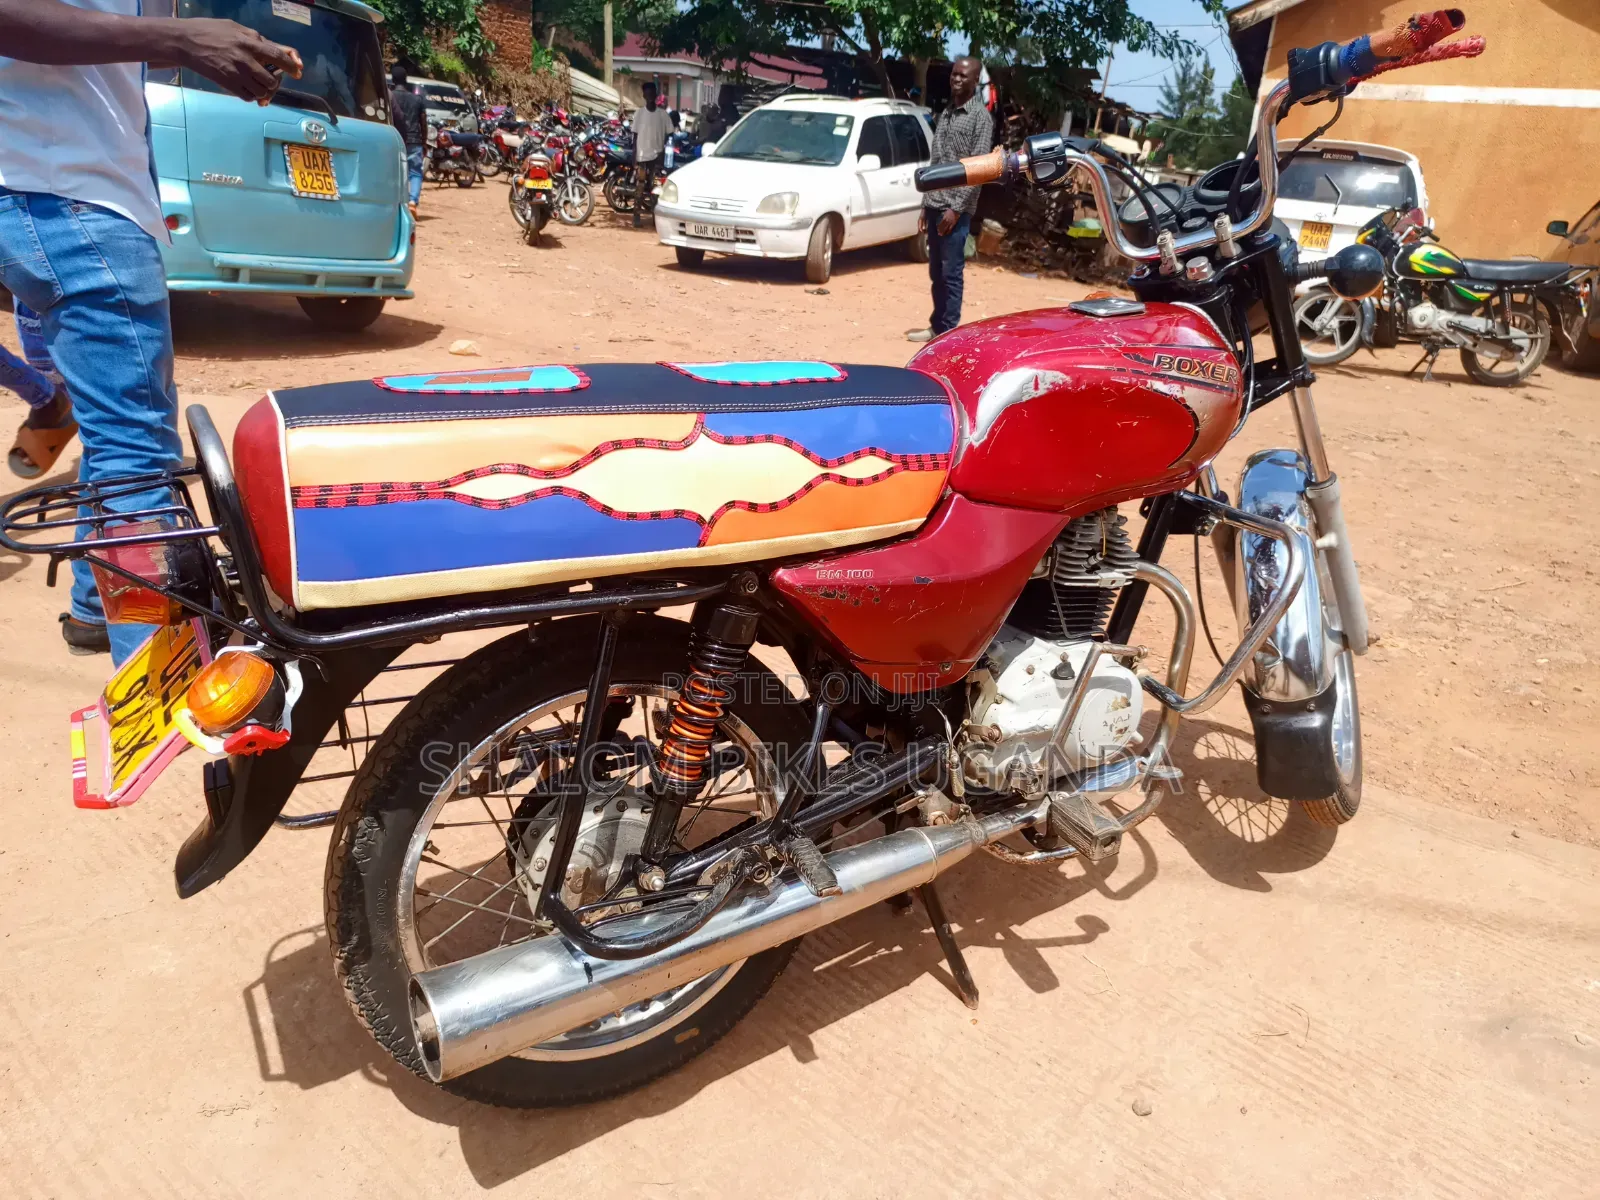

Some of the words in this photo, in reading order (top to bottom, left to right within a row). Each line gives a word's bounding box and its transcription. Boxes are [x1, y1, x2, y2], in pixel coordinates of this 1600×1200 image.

[302, 151, 329, 172] UAX
[299, 171, 333, 191] 825G
[694, 224, 708, 236] UAR
[1153, 352, 1239, 384] BOXER
[816, 569, 842, 580] BM
[847, 568, 874, 580] 100
